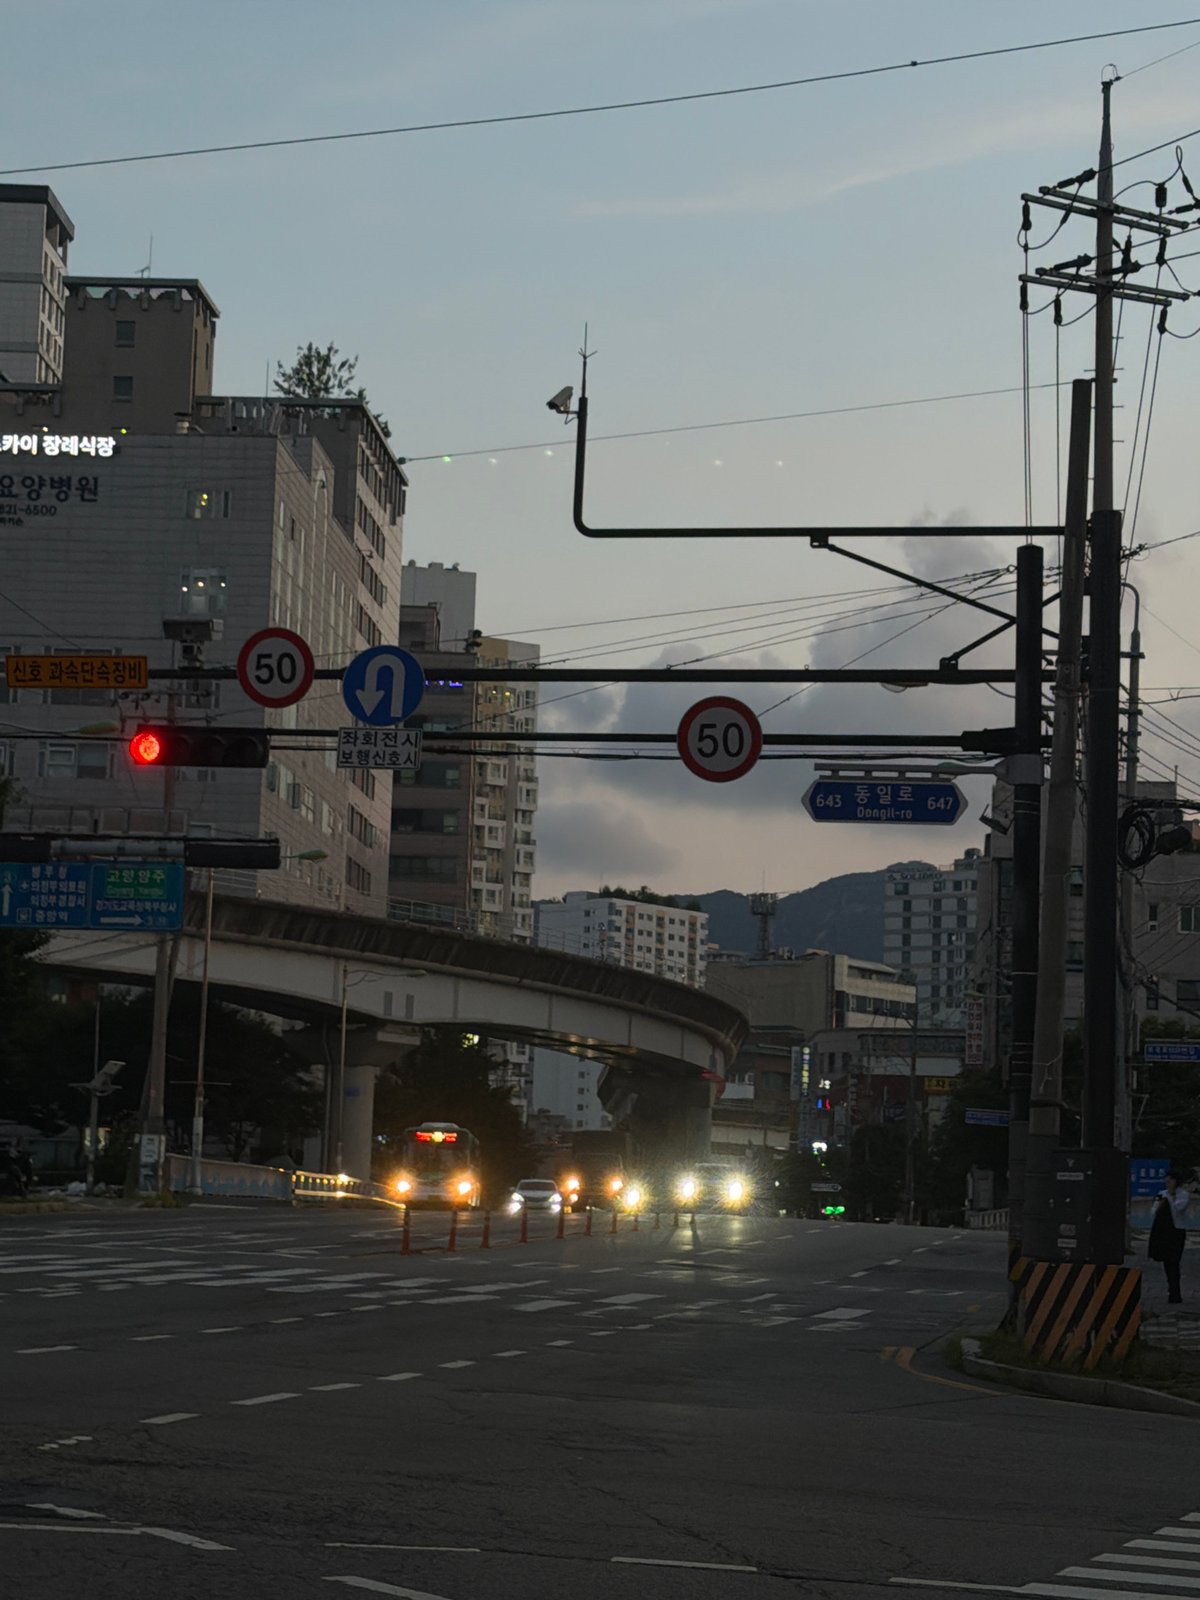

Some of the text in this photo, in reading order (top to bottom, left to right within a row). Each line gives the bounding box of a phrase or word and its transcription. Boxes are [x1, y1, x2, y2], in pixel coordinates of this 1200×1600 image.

[0, 434, 38, 456] 카이
[0, 474, 98, 503] 요양병원
[12, 660, 143, 685] 신호 과속단속장비
[254, 652, 298, 685] 50
[341, 730, 419, 749] 좌회전시
[696, 722, 745, 759] 50
[339, 749, 418, 767] 보행신호시
[815, 794, 842, 808] 643
[854, 785, 915, 805] 동일로
[927, 796, 953, 810] 647
[856, 806, 913, 821] Dongil-ro
